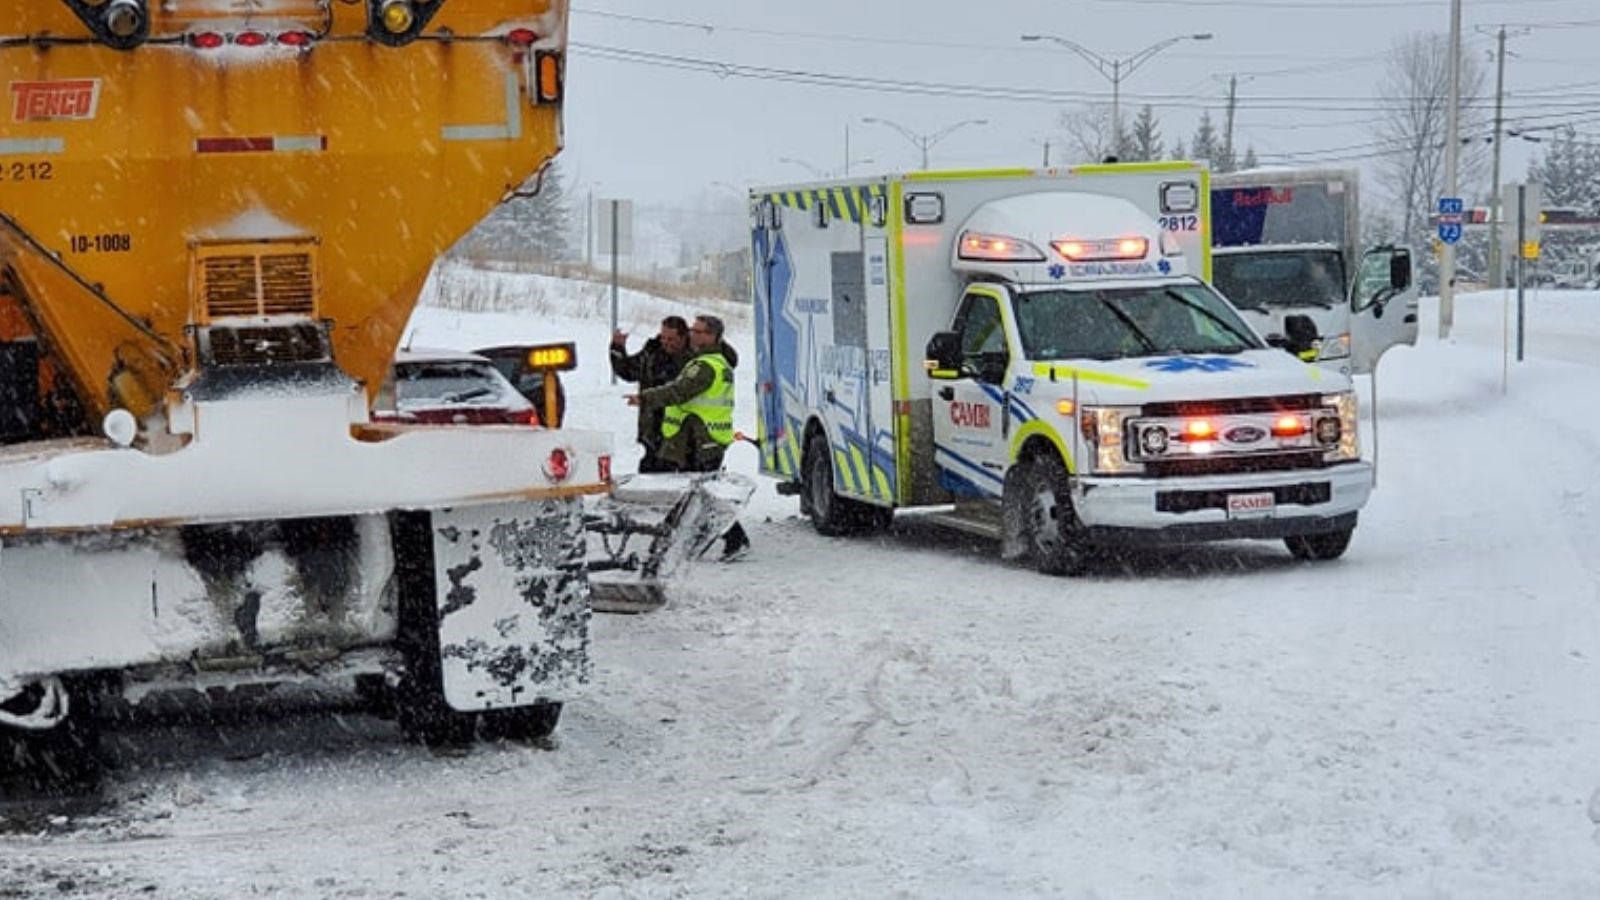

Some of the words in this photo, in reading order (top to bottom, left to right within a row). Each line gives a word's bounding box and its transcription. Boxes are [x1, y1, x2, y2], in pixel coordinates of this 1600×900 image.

[11, 80, 95, 121] TENCO
[0, 162, 53, 180] -212
[1158, 215, 1198, 231] 2812
[70, 234, 131, 253] 10-1008
